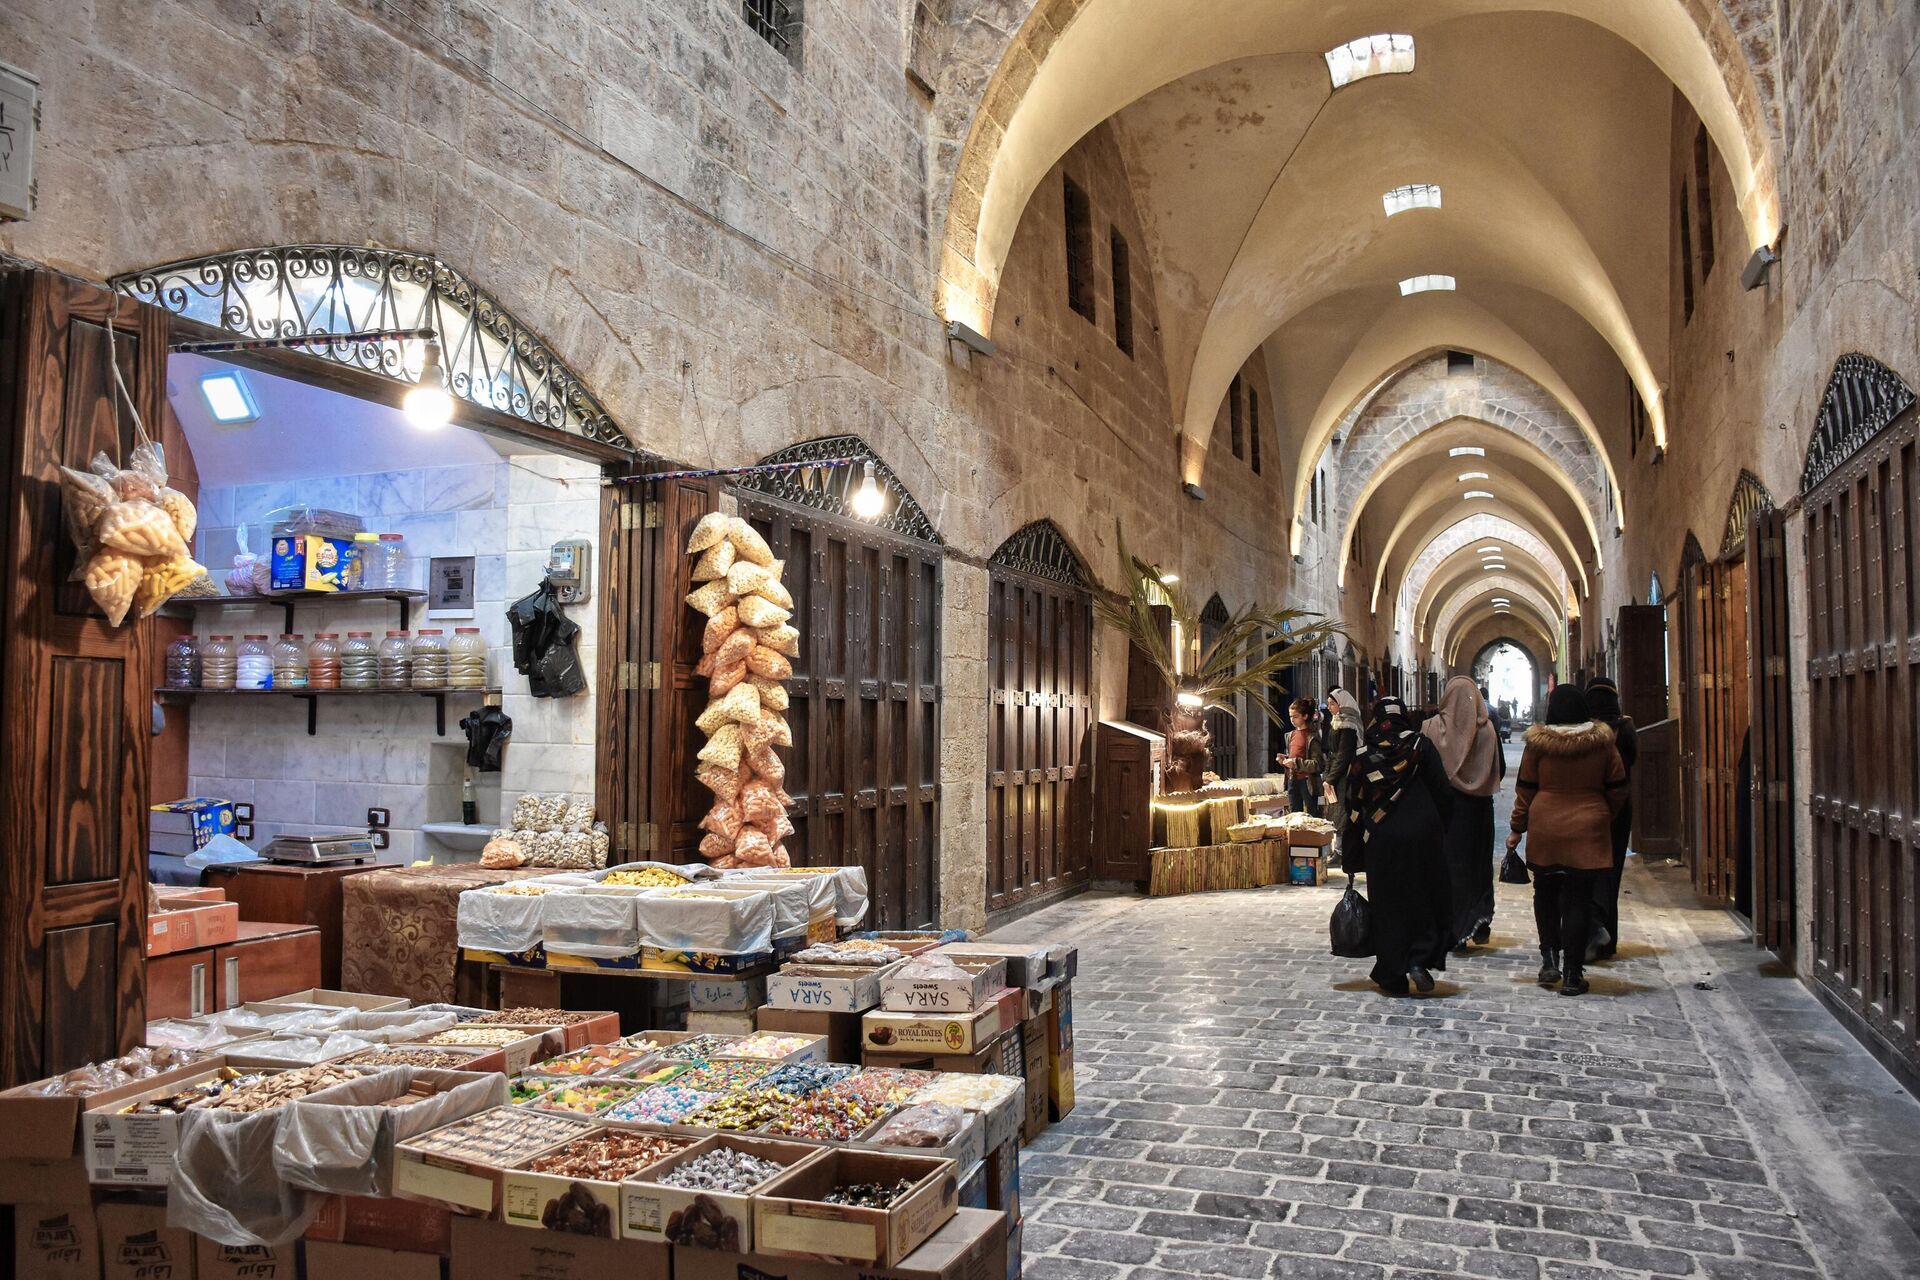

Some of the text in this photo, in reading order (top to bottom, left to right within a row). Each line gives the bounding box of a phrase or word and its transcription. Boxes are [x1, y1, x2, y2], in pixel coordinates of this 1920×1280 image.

[790, 989, 832, 1006] SARA
[904, 991, 949, 1006] SARA
[898, 1028, 943, 1037] ROYAL DATES
[123, 1245, 166, 1259] Larva
[224, 1245, 270, 1258] Larva
